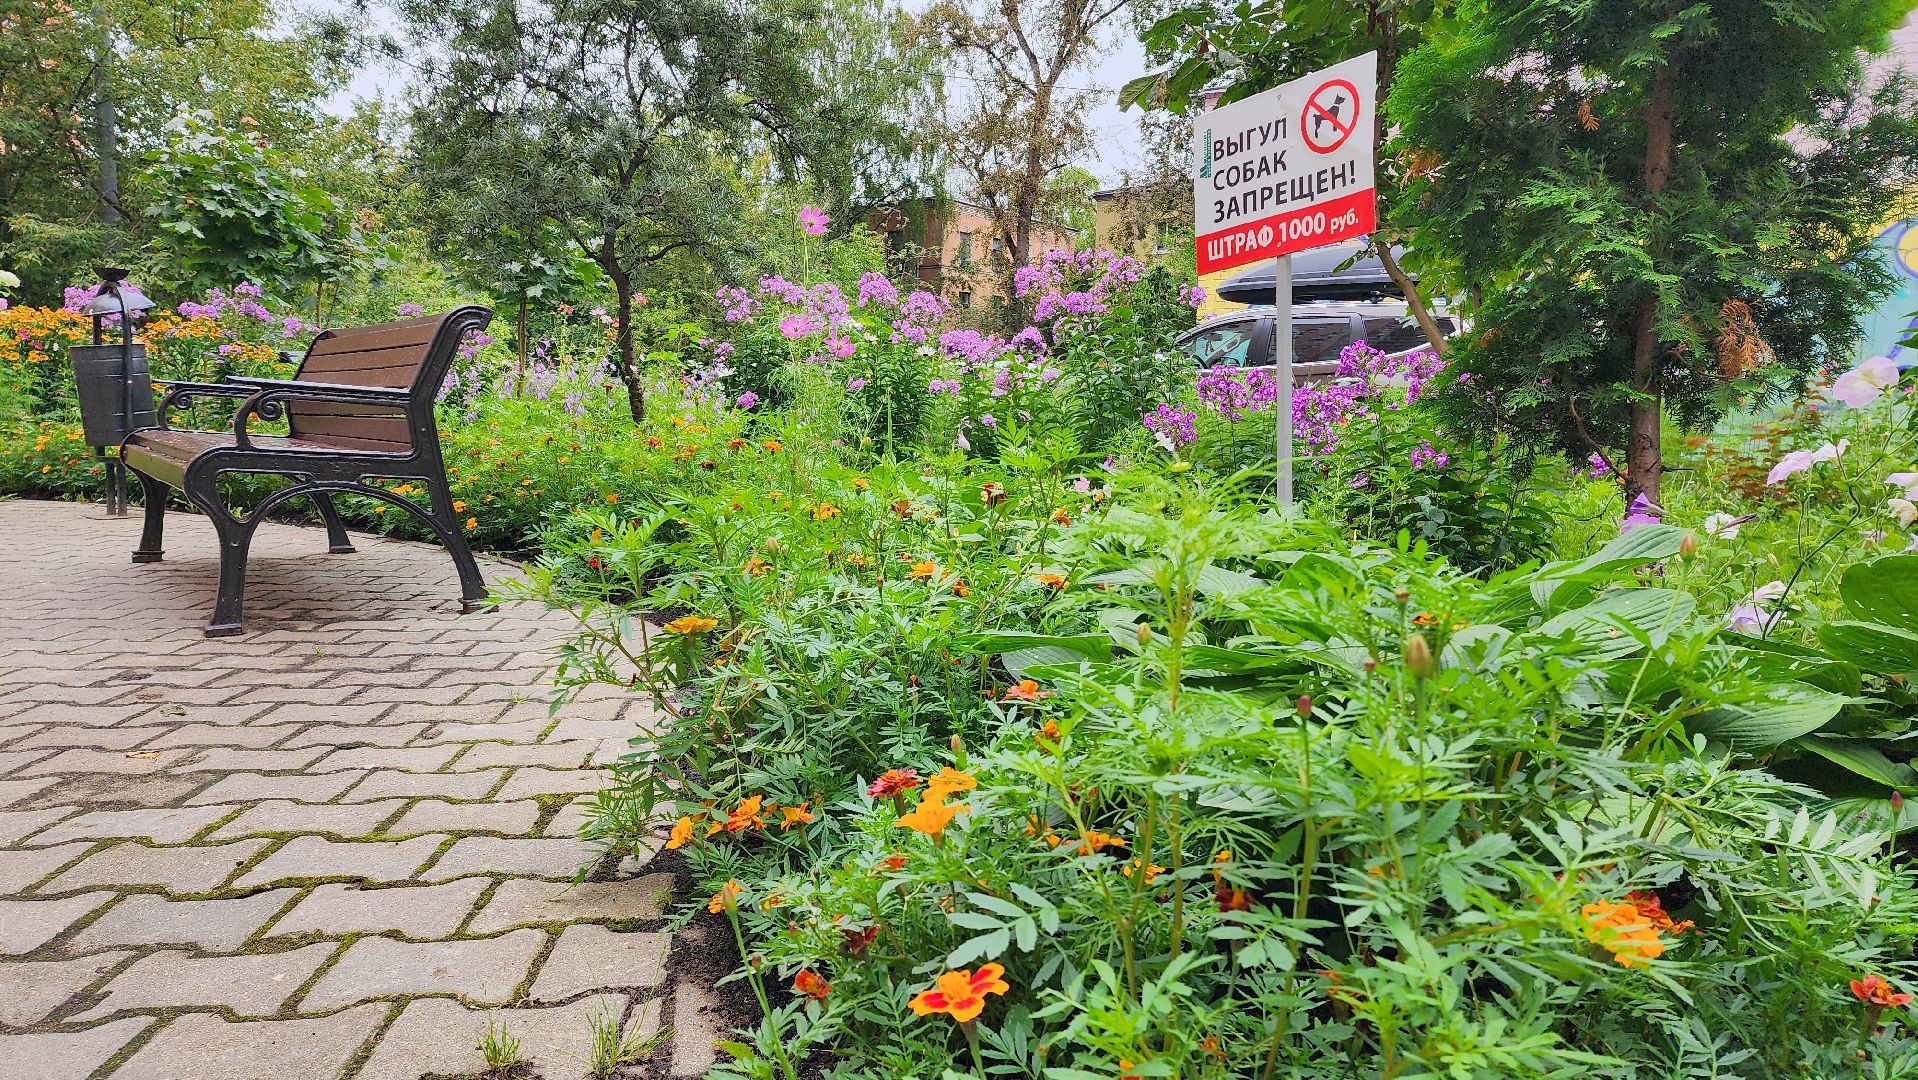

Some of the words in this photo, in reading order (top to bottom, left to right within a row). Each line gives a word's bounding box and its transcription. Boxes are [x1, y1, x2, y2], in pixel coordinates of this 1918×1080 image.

[1213, 117, 1287, 162] ВЫГУЛ
[1213, 149, 1288, 191] СОБАК
[1213, 159, 1356, 224] ЗАПРЕЩЕН!
[1207, 224, 1274, 262] ШТРАФ
[1278, 212, 1326, 243] 1000
[1330, 207, 1359, 235] руб.
